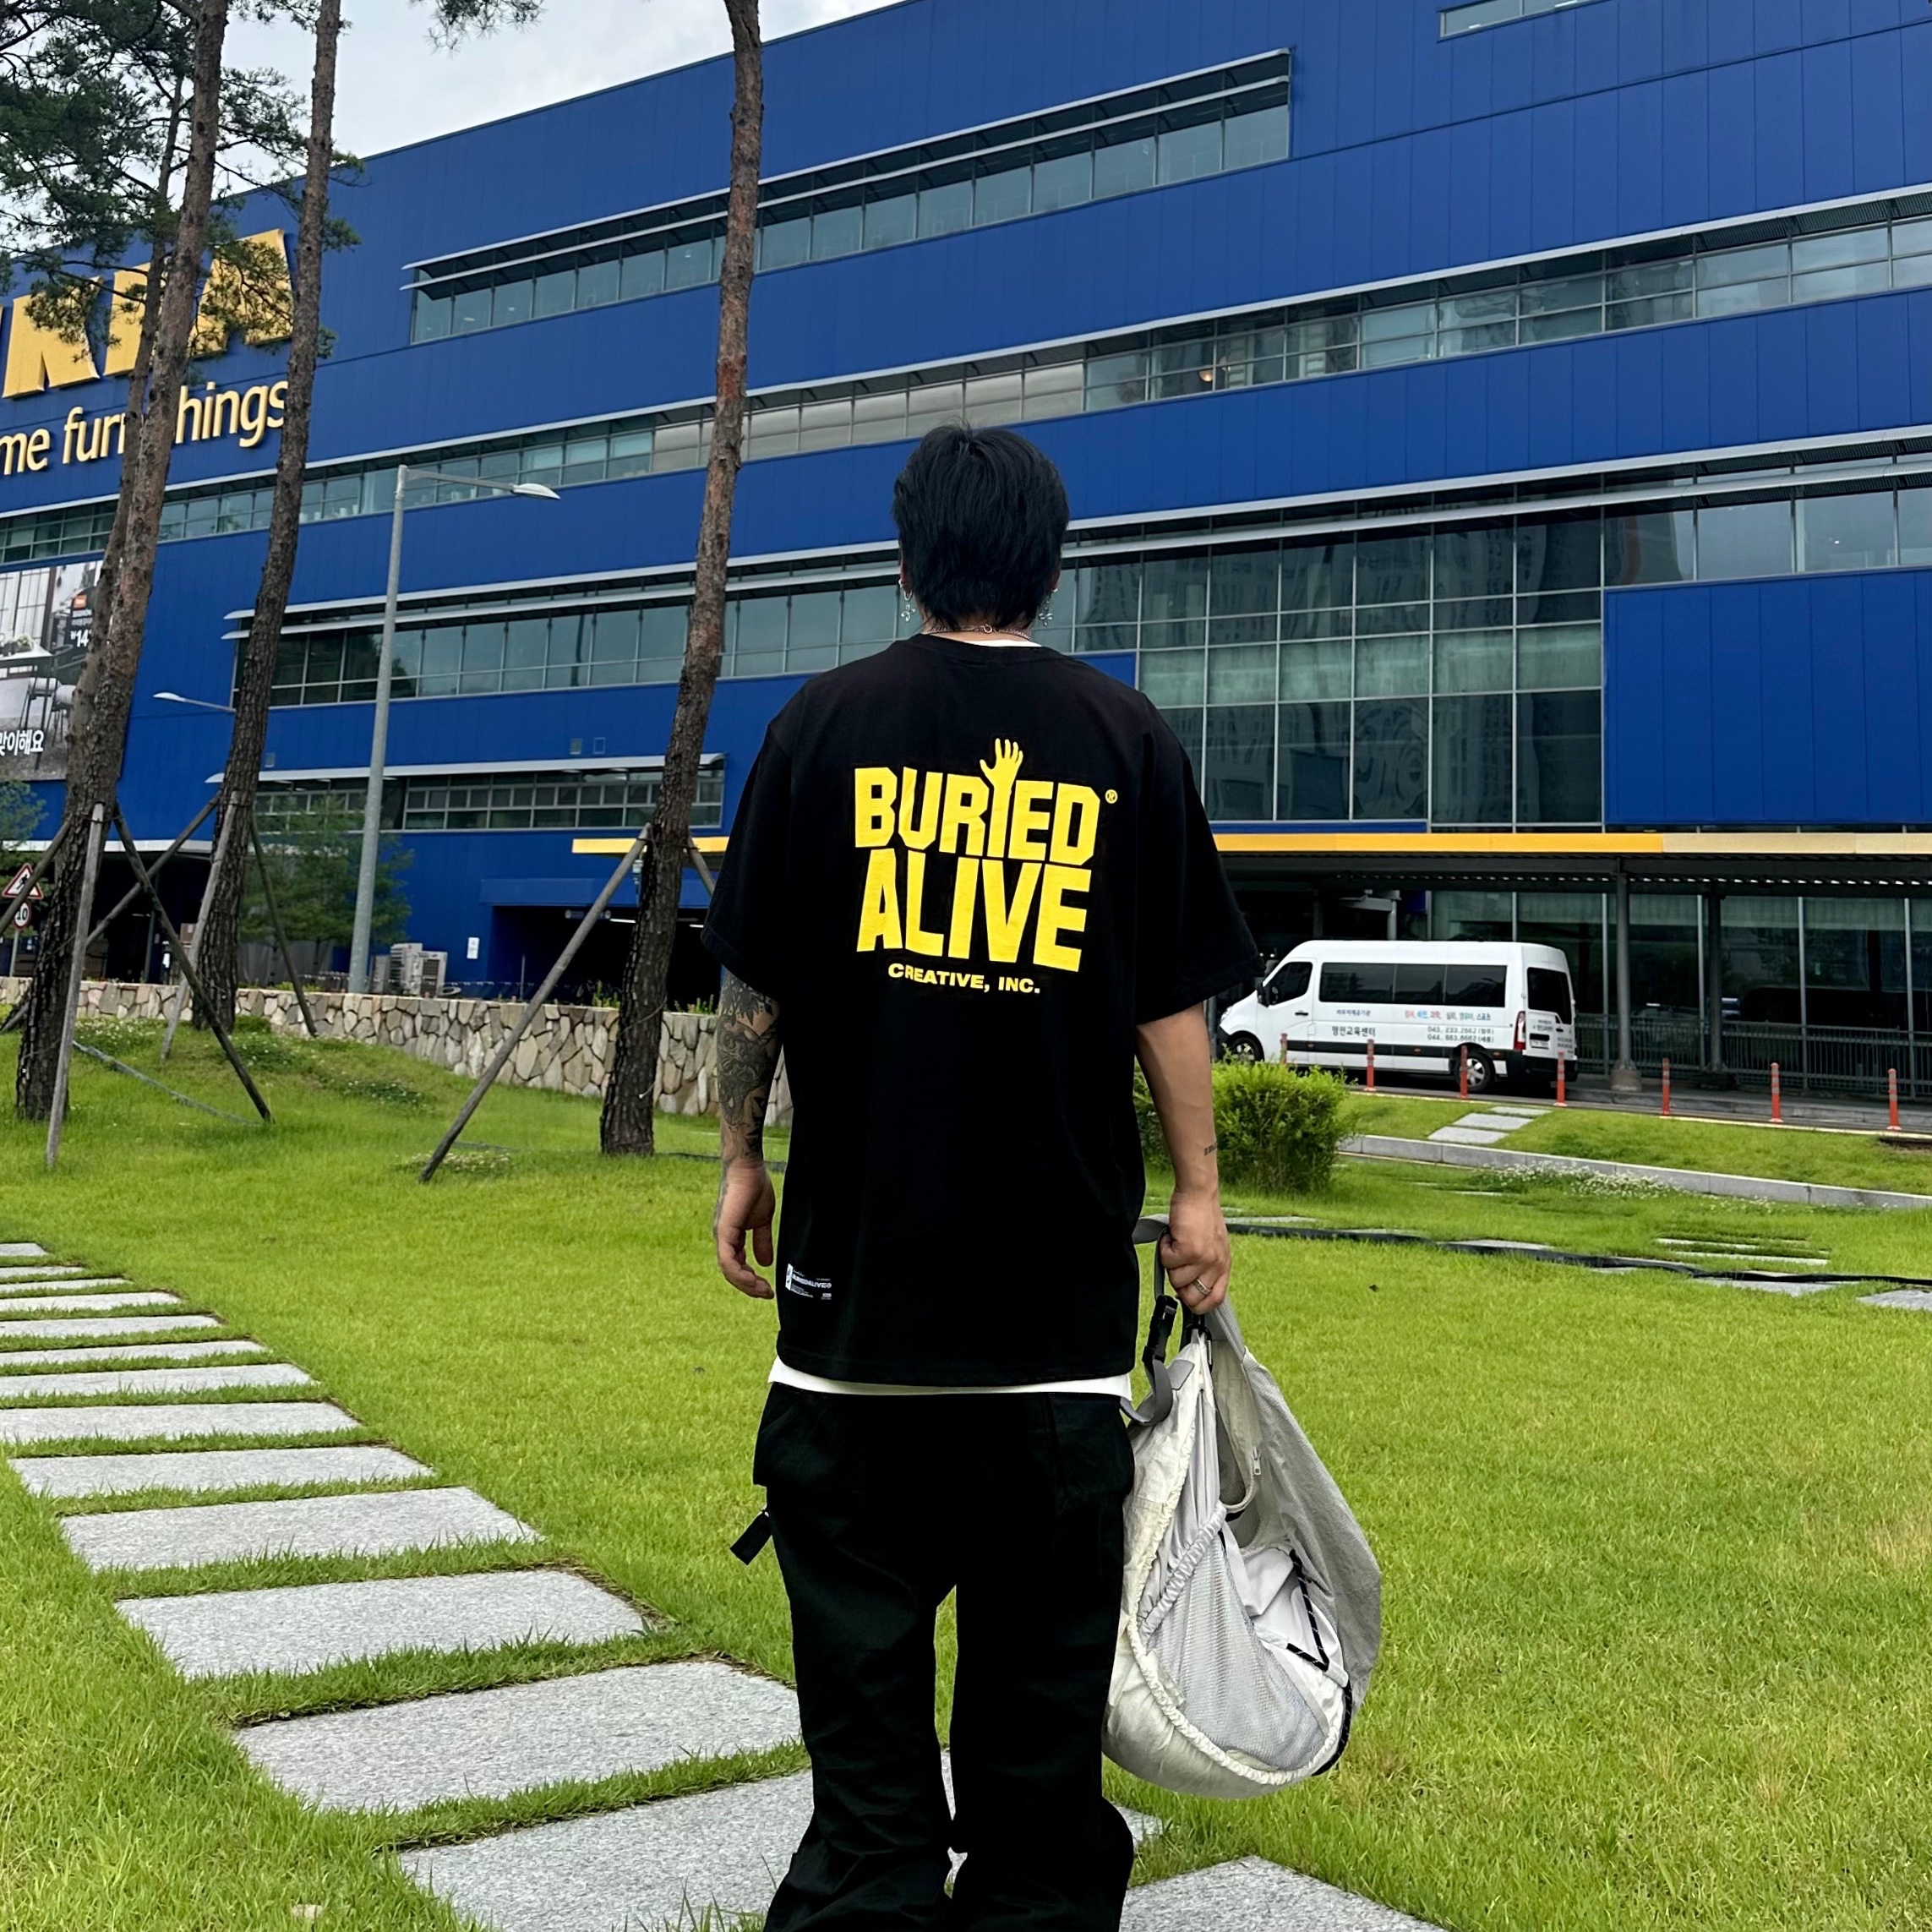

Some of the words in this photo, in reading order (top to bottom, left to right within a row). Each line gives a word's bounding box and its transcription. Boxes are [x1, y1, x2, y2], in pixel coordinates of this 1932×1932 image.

[0, 228, 296, 398] KA
[62, 381, 288, 465] furhings
[856, 848, 1092, 973] ALIVE
[887, 963, 990, 993] CREATIVE,
[998, 976, 1040, 994] INC.
